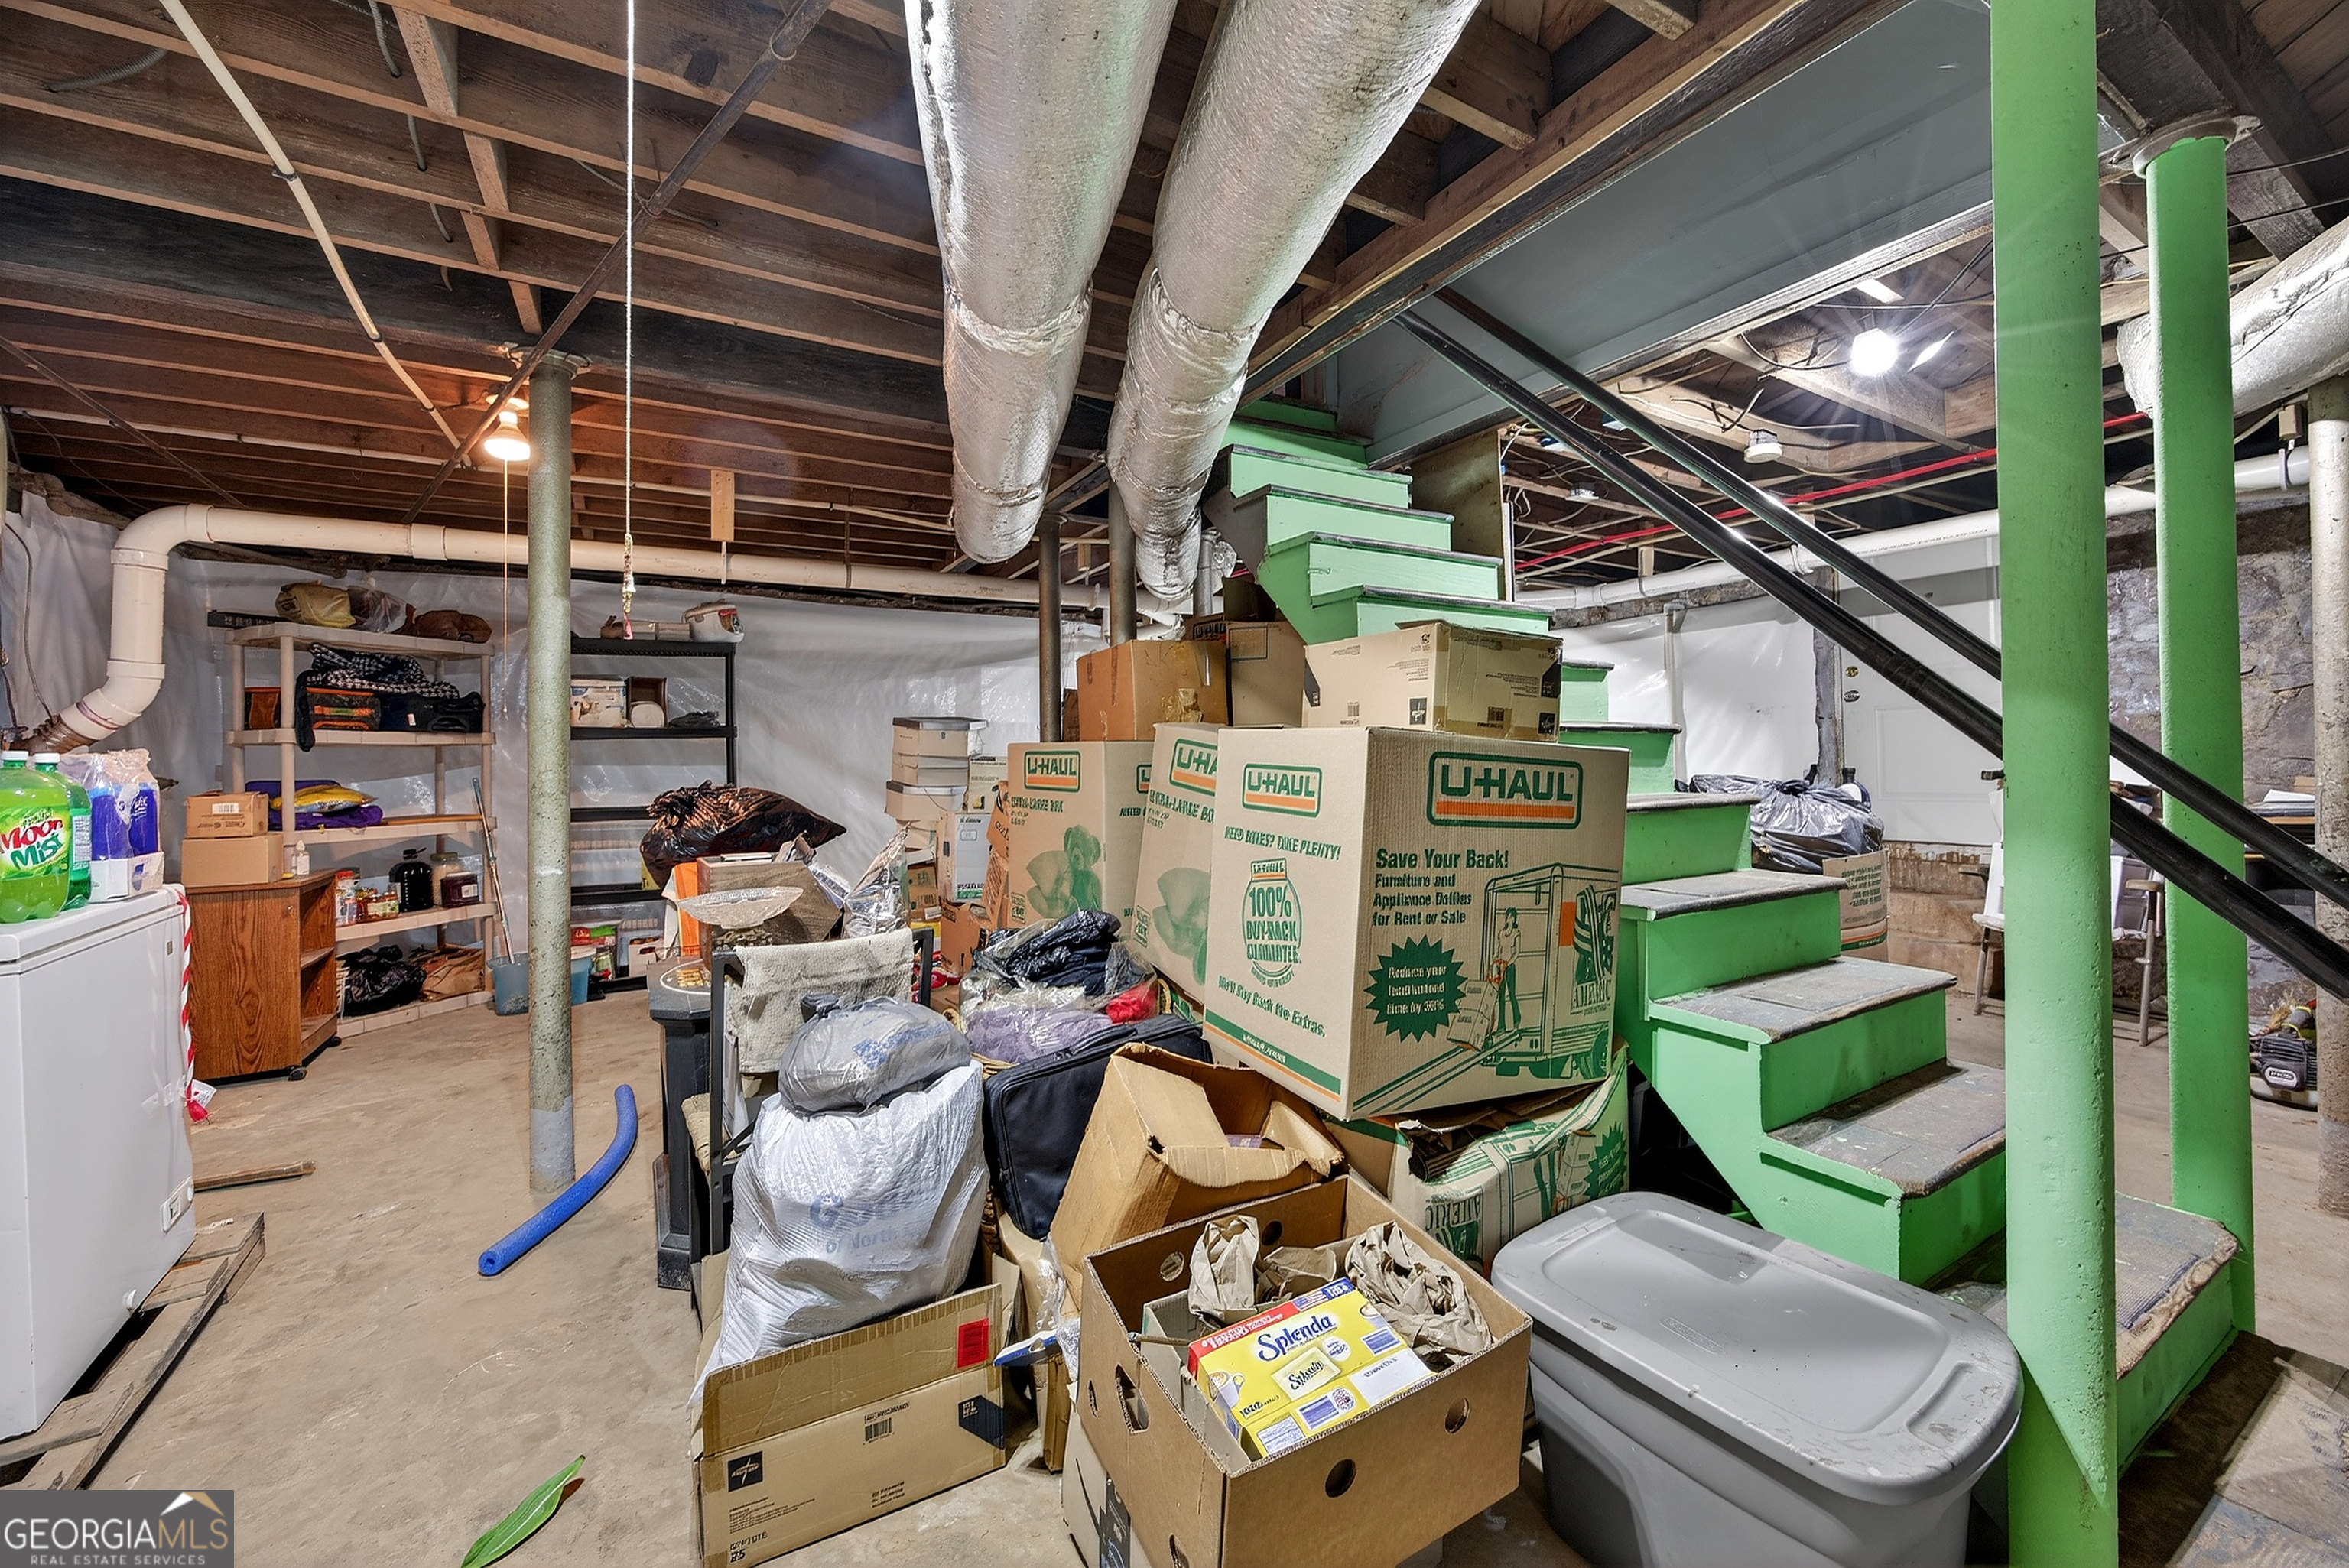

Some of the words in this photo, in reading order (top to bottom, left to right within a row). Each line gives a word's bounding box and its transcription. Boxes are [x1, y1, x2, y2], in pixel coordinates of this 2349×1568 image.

[1028, 758, 1077, 776] U-HAUL
[1247, 771, 1315, 797] U-HAUL
[1441, 765, 1573, 801] U-HAUL
[11, 832, 63, 870] Mist
[1224, 826, 1244, 842] NEED
[1245, 829, 1275, 848] BOXES?
[1277, 836, 1299, 852] TAKE
[1299, 840, 1341, 860] PLENTY!
[1376, 848, 1418, 869] Save
[1425, 849, 1460, 869] Your
[1466, 849, 1509, 868] Back!
[1376, 873, 1431, 888] Furniture
[1434, 874, 1456, 888] and
[1249, 885, 1292, 917] 100%
[1373, 892, 1431, 910] Appliance
[1372, 911, 1390, 926] for
[1394, 911, 1421, 925] Rent
[1425, 913, 1438, 925] or
[1441, 910, 1466, 924] Sale
[1246, 920, 1298, 941] BUY-BACK
[1389, 966, 1424, 979] Reduce
[1426, 966, 1447, 978] your
[1236, 984, 1252, 1004] Buy
[1252, 992, 1273, 1013] Back
[1275, 1002, 1291, 1021] the
[1387, 1002, 1408, 1015] time
[1410, 1002, 1421, 1015] by
[1257, 1315, 1332, 1361] Splenda
